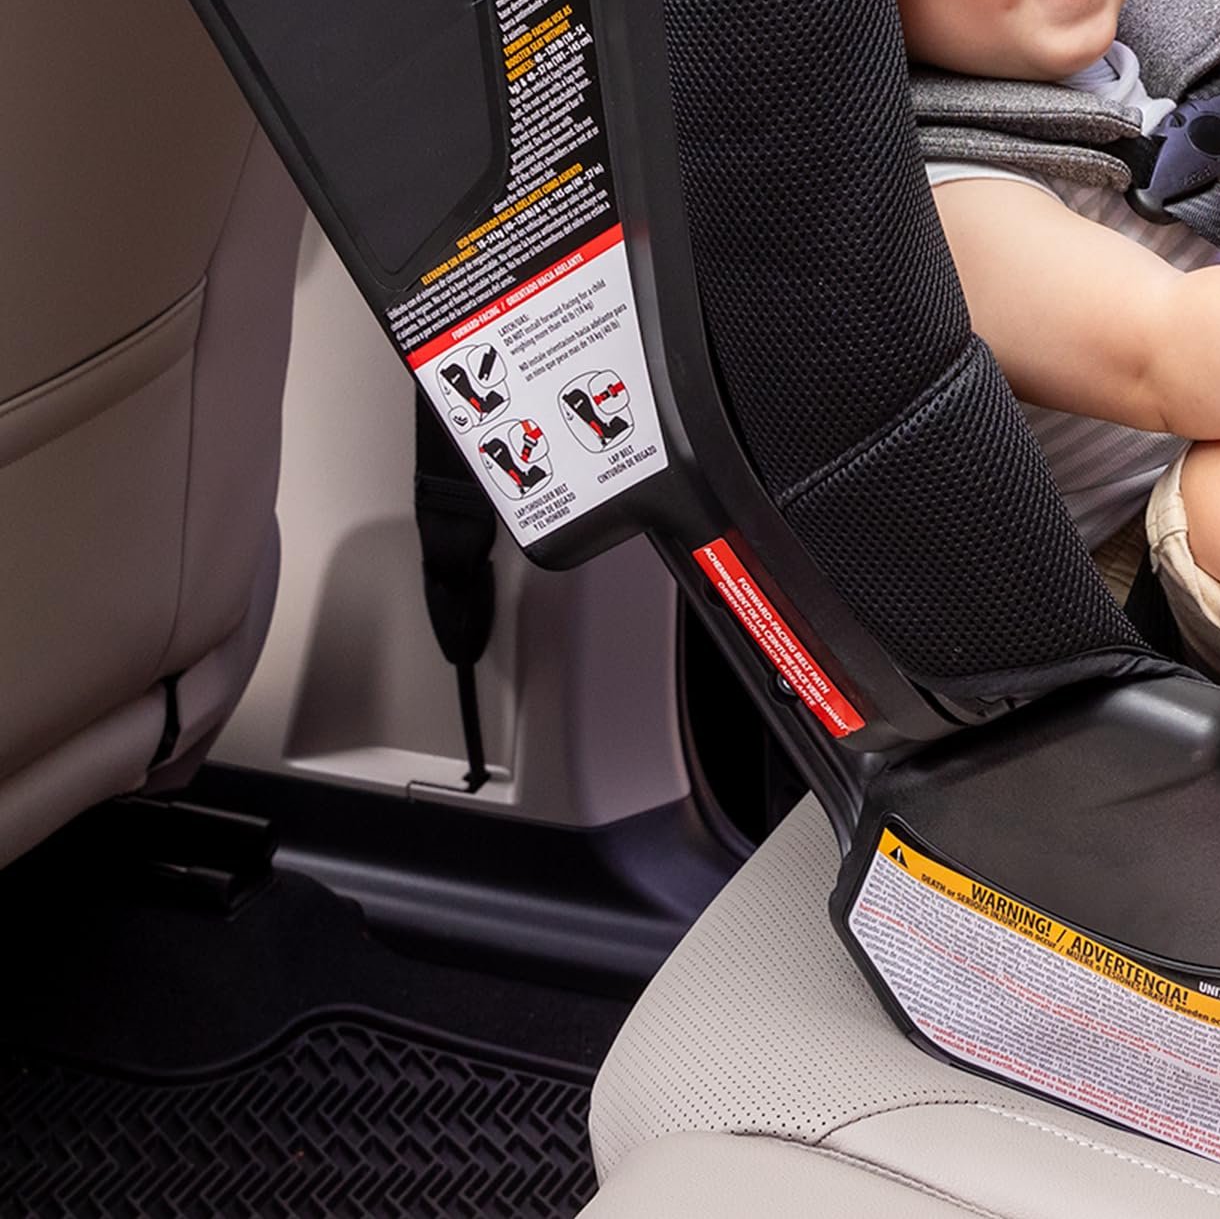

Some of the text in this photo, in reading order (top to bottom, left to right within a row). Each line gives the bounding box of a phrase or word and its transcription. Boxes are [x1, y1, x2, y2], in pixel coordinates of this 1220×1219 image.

[451, 305, 499, 340] FORWARD-FACING
[505, 281, 538, 306] ORIENTADO
[536, 271, 554, 286] HACIA
[553, 253, 582, 275] ADELANTE
[503, 336, 513, 346] DO
[512, 329, 524, 340] NOT
[523, 319, 541, 333] install
[540, 306, 562, 323] forward
[578, 290, 588, 300] for
[591, 279, 606, 292] child
[509, 336, 536, 357] weighing
[534, 329, 548, 340] more
[547, 320, 562, 332] than
[560, 315, 569, 324] 40
[568, 311, 575, 320] lb
[583, 299, 595, 313] kg)
[519, 362, 528, 372] NO
[528, 351, 546, 366] instale
[575, 324, 590, 337] hacia
[589, 310, 614, 328] adelante
[614, 304, 628, 316] para
[546, 360, 557, 371] que
[556, 352, 569, 364] pese
[579, 339, 587, 349] de
[593, 329, 603, 342] kg
[610, 319, 621, 332] lb)
[608, 445, 634, 465] LAP BELT
[625, 458, 635, 468] DE
[633, 445, 657, 463] REGAZO
[514, 483, 568, 519] LAP/SHOULDER BELT
[538, 520, 546, 529] EL
[545, 505, 570, 525] HOMBRO
[545, 504, 554, 514] DE
[553, 491, 576, 510] REGAZO
[738, 576, 829, 693] FORWARD-FACING BELT PATH
[761, 637, 782, 663] HACIA
[780, 662, 815, 706] ADELANTE
[921, 874, 946, 895] DEATH
[957, 892, 989, 915] SERIOUS
[991, 911, 1018, 930] INJURY
[1019, 926, 1034, 937] can
[1036, 934, 1056, 948] occur
[1102, 967, 1140, 991] LESIONES
[1141, 986, 1173, 1006] GRAVES
[1174, 1004, 1209, 1022] pueden
[972, 884, 1189, 1005] WARNING! / ADVERTENCIA!
